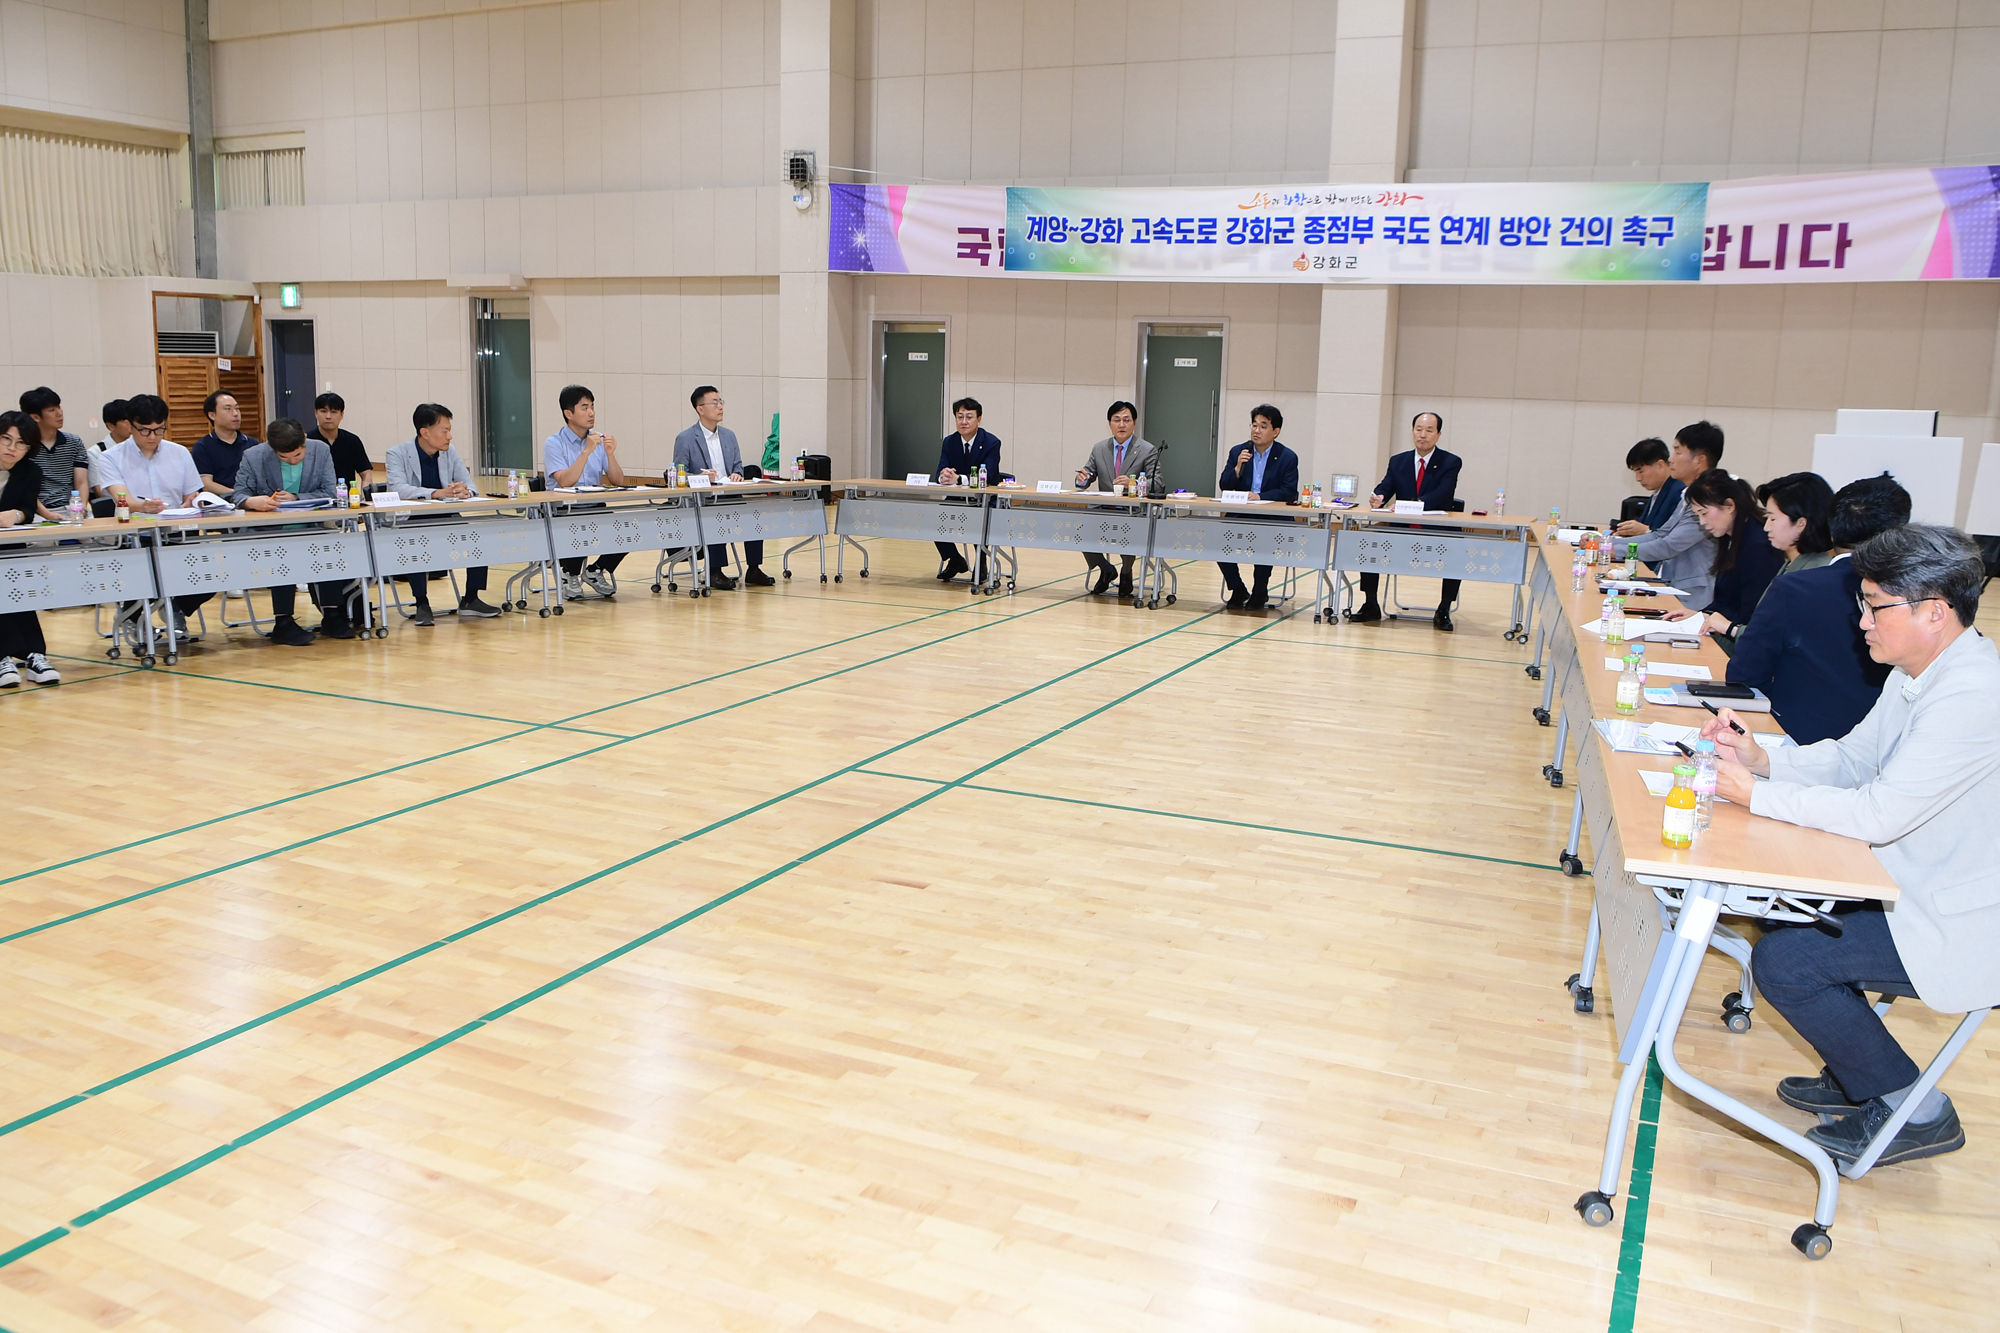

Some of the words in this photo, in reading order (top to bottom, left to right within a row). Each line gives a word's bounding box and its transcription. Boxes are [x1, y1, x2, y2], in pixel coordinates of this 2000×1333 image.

[1324, 192, 1347, 205] 함께
[1350, 194, 1373, 205] 만드는
[1375, 191, 1424, 207] 강화
[1026, 215, 1124, 245] 계양~강화
[1130, 216, 1218, 246] 고속도로
[1225, 215, 1295, 246] 강화군
[1303, 215, 1374, 246] 종점부
[1382, 215, 1430, 246] 국도
[1439, 215, 1491, 247] 연계
[1499, 215, 1552, 247] 방안
[1559, 215, 1613, 247] 건의
[1621, 215, 1675, 248] 촉구
[1312, 255, 1358, 269] 강화군
